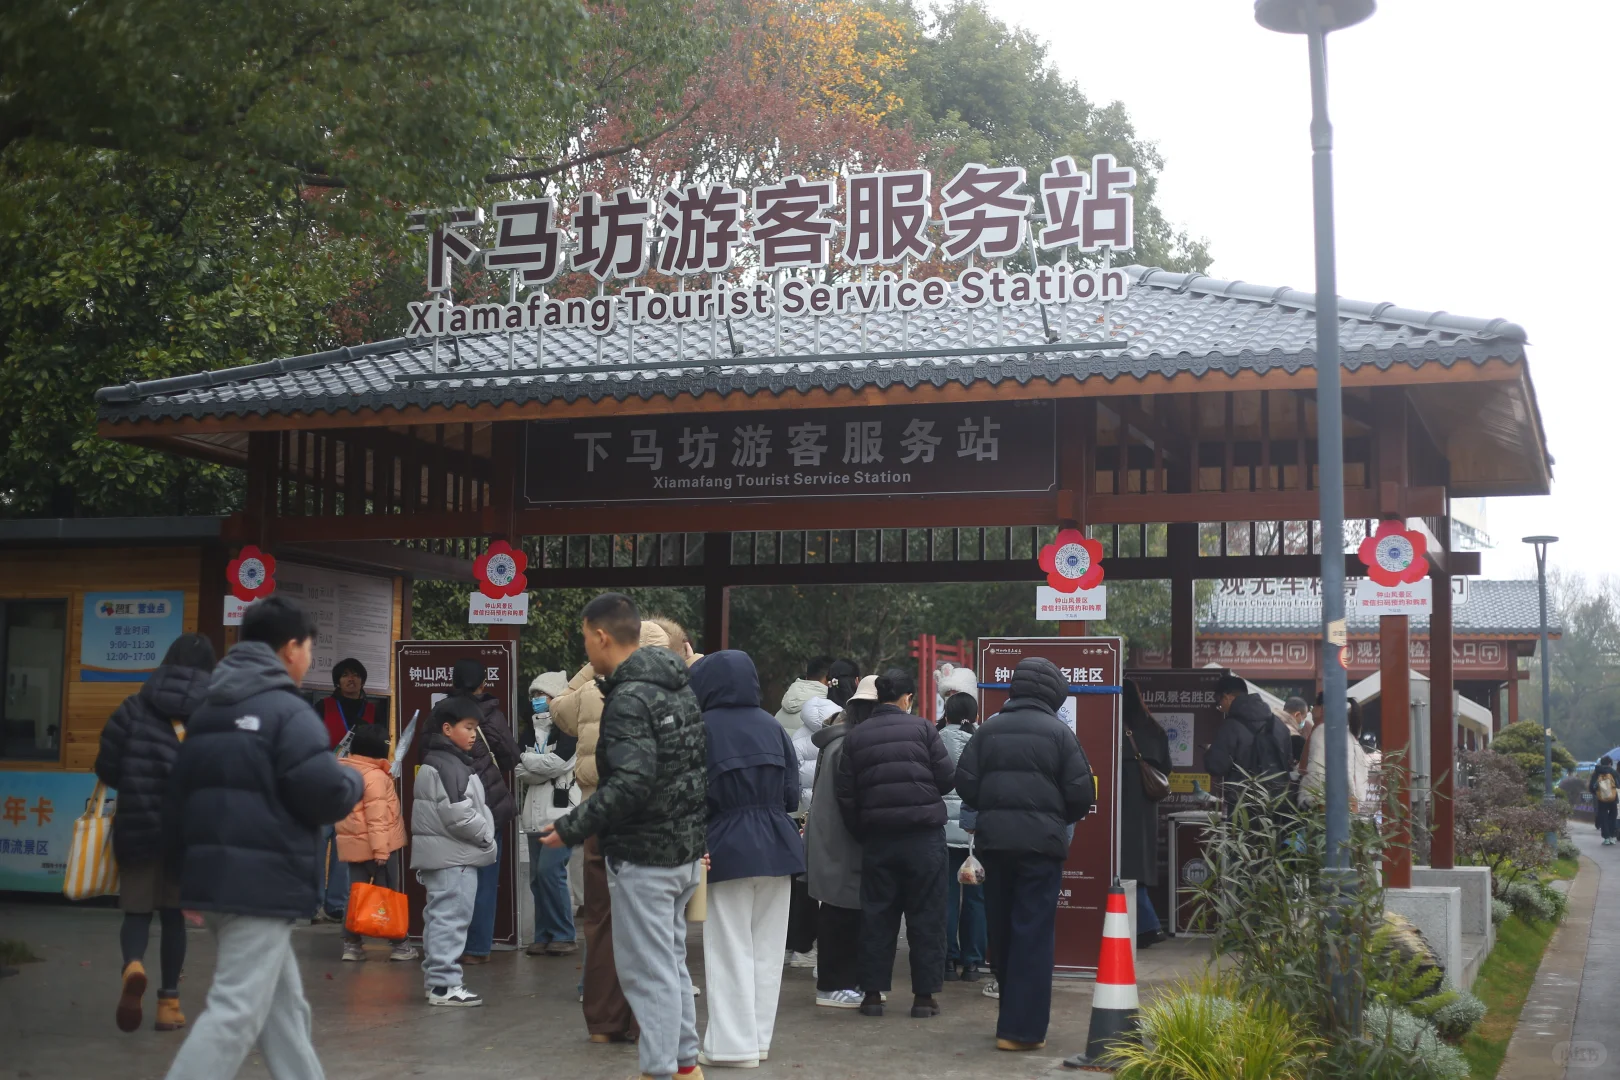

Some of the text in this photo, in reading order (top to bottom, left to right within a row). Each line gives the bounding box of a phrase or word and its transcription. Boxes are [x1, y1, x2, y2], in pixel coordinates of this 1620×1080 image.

[410, 157, 1134, 290] 下马坊游客服务站
[411, 265, 1125, 334] Xiamafang Tourist Service Station
[573, 416, 1001, 472] 下马坊游客服务站
[653, 469, 911, 491] Xiamafang Tourist Service Station
[137, 602, 166, 615] 营业点
[1041, 604, 1102, 612] 微信扫码预约和购票
[1361, 598, 1428, 607] 微信扫码预约和购票
[114, 625, 150, 636] 营业时间
[109, 640, 155, 649] 9:00-11:30
[106, 652, 156, 661] 12:00-17:00
[1142, 690, 1216, 703] 山风景名胜区
[3, 796, 54, 827] 年卡
